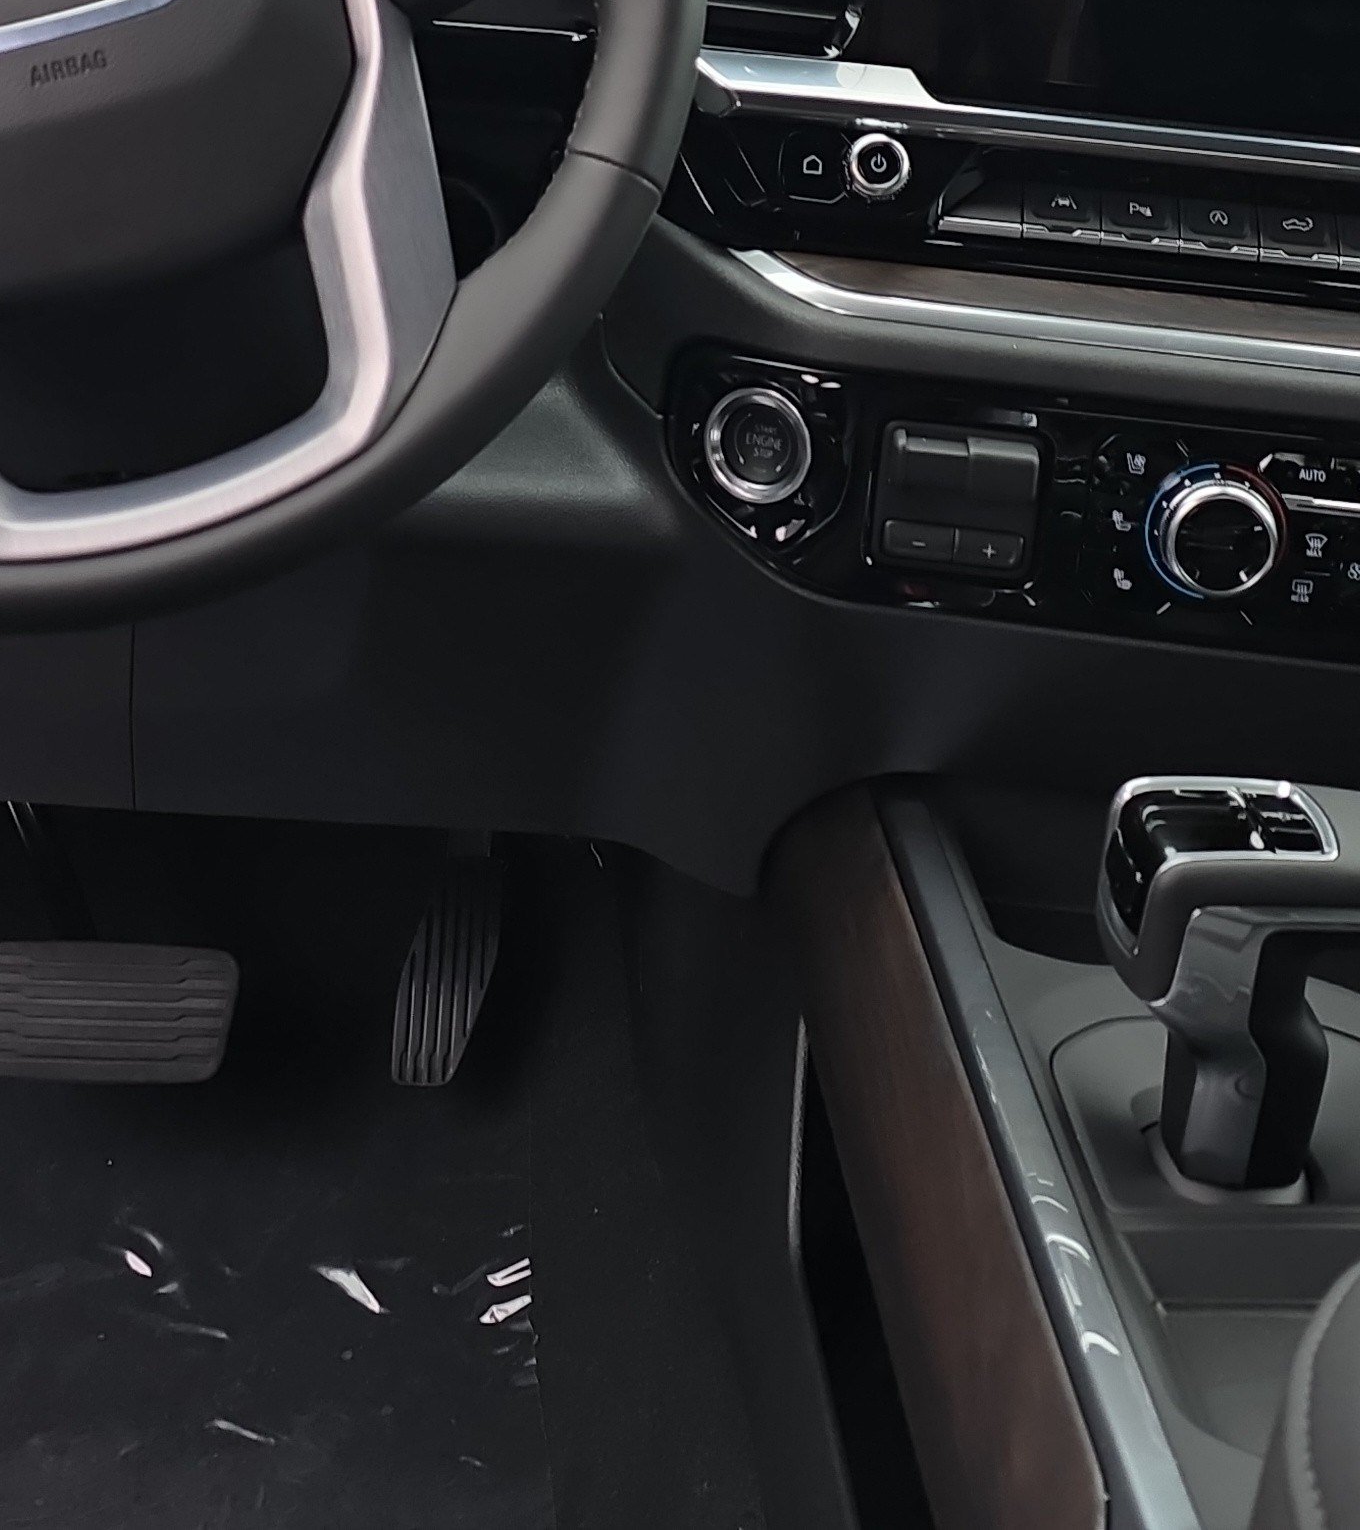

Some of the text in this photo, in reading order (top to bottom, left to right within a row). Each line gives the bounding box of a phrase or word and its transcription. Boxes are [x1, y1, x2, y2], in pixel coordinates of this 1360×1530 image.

[30, 49, 107, 88] AIRBAG
[746, 432, 782, 452] ENGINE
[1299, 468, 1327, 483] AUTO
